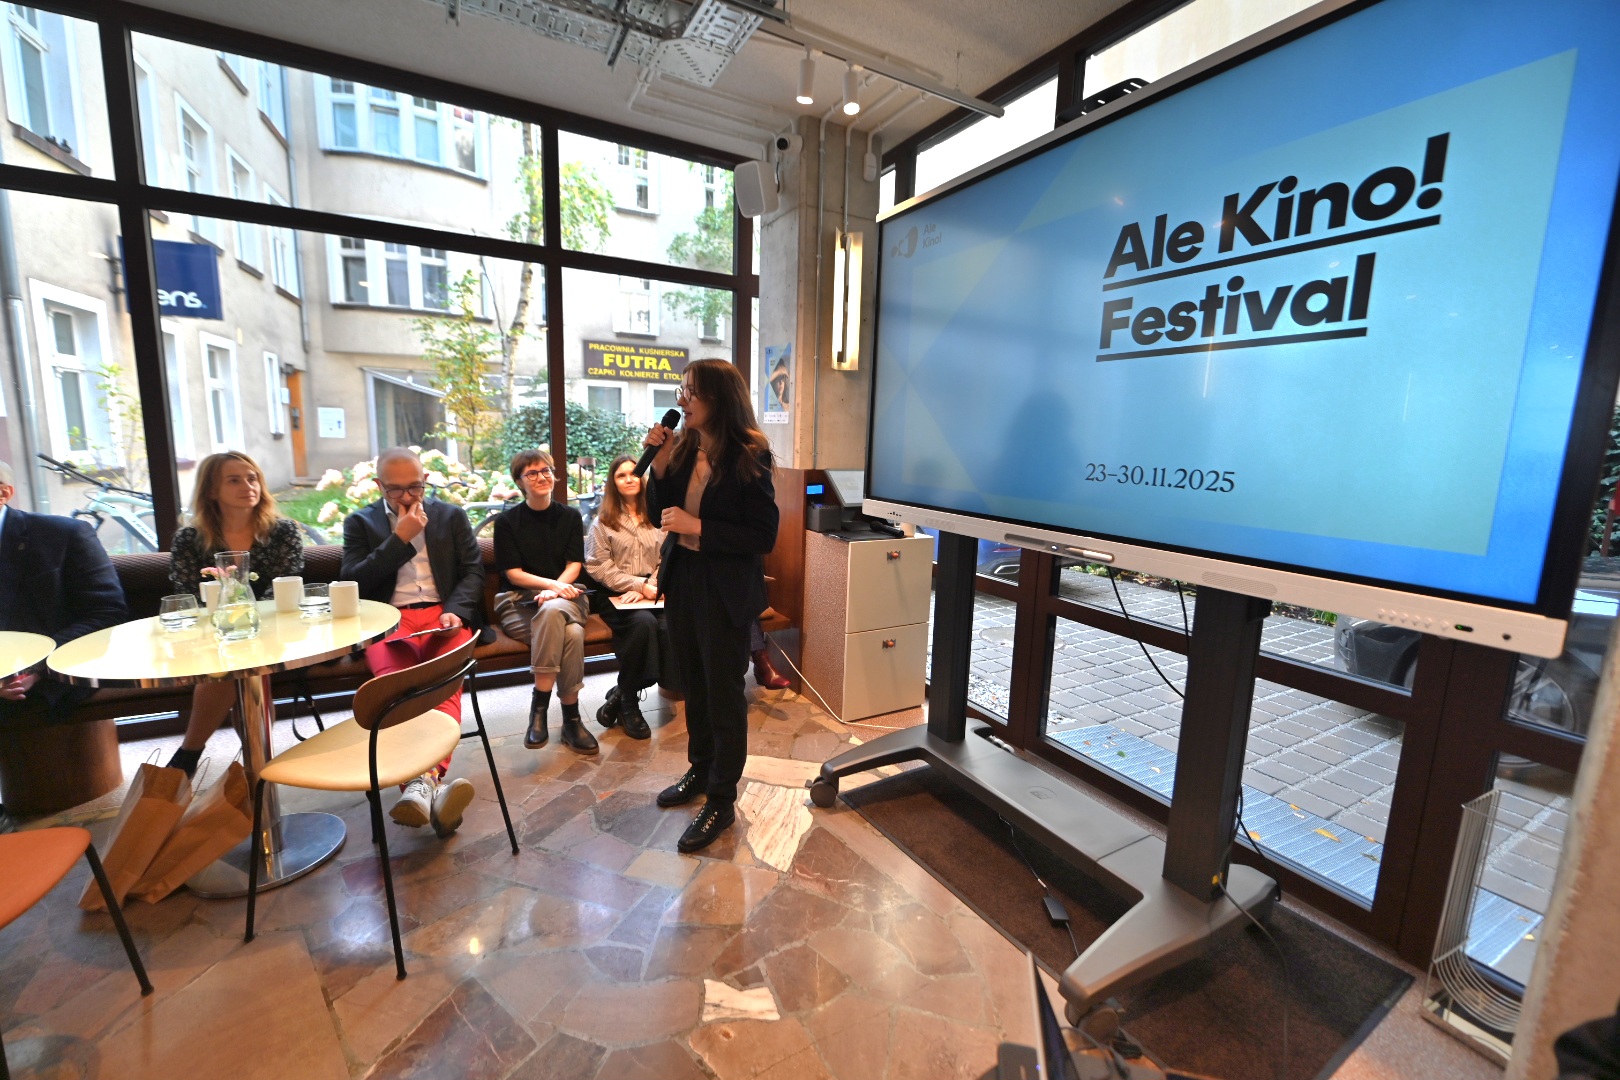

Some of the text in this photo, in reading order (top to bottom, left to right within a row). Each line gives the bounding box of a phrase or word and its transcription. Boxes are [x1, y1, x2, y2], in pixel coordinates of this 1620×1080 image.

[1103, 132, 1450, 279] Ale Kino!
[1099, 252, 1376, 350] Festival
[589, 342, 685, 357] PRACOWNIA KUŚNIERSKA
[603, 353, 672, 371] FUTRA
[587, 367, 616, 376] CZAPKI
[619, 369, 660, 379] KOŁNIERZE
